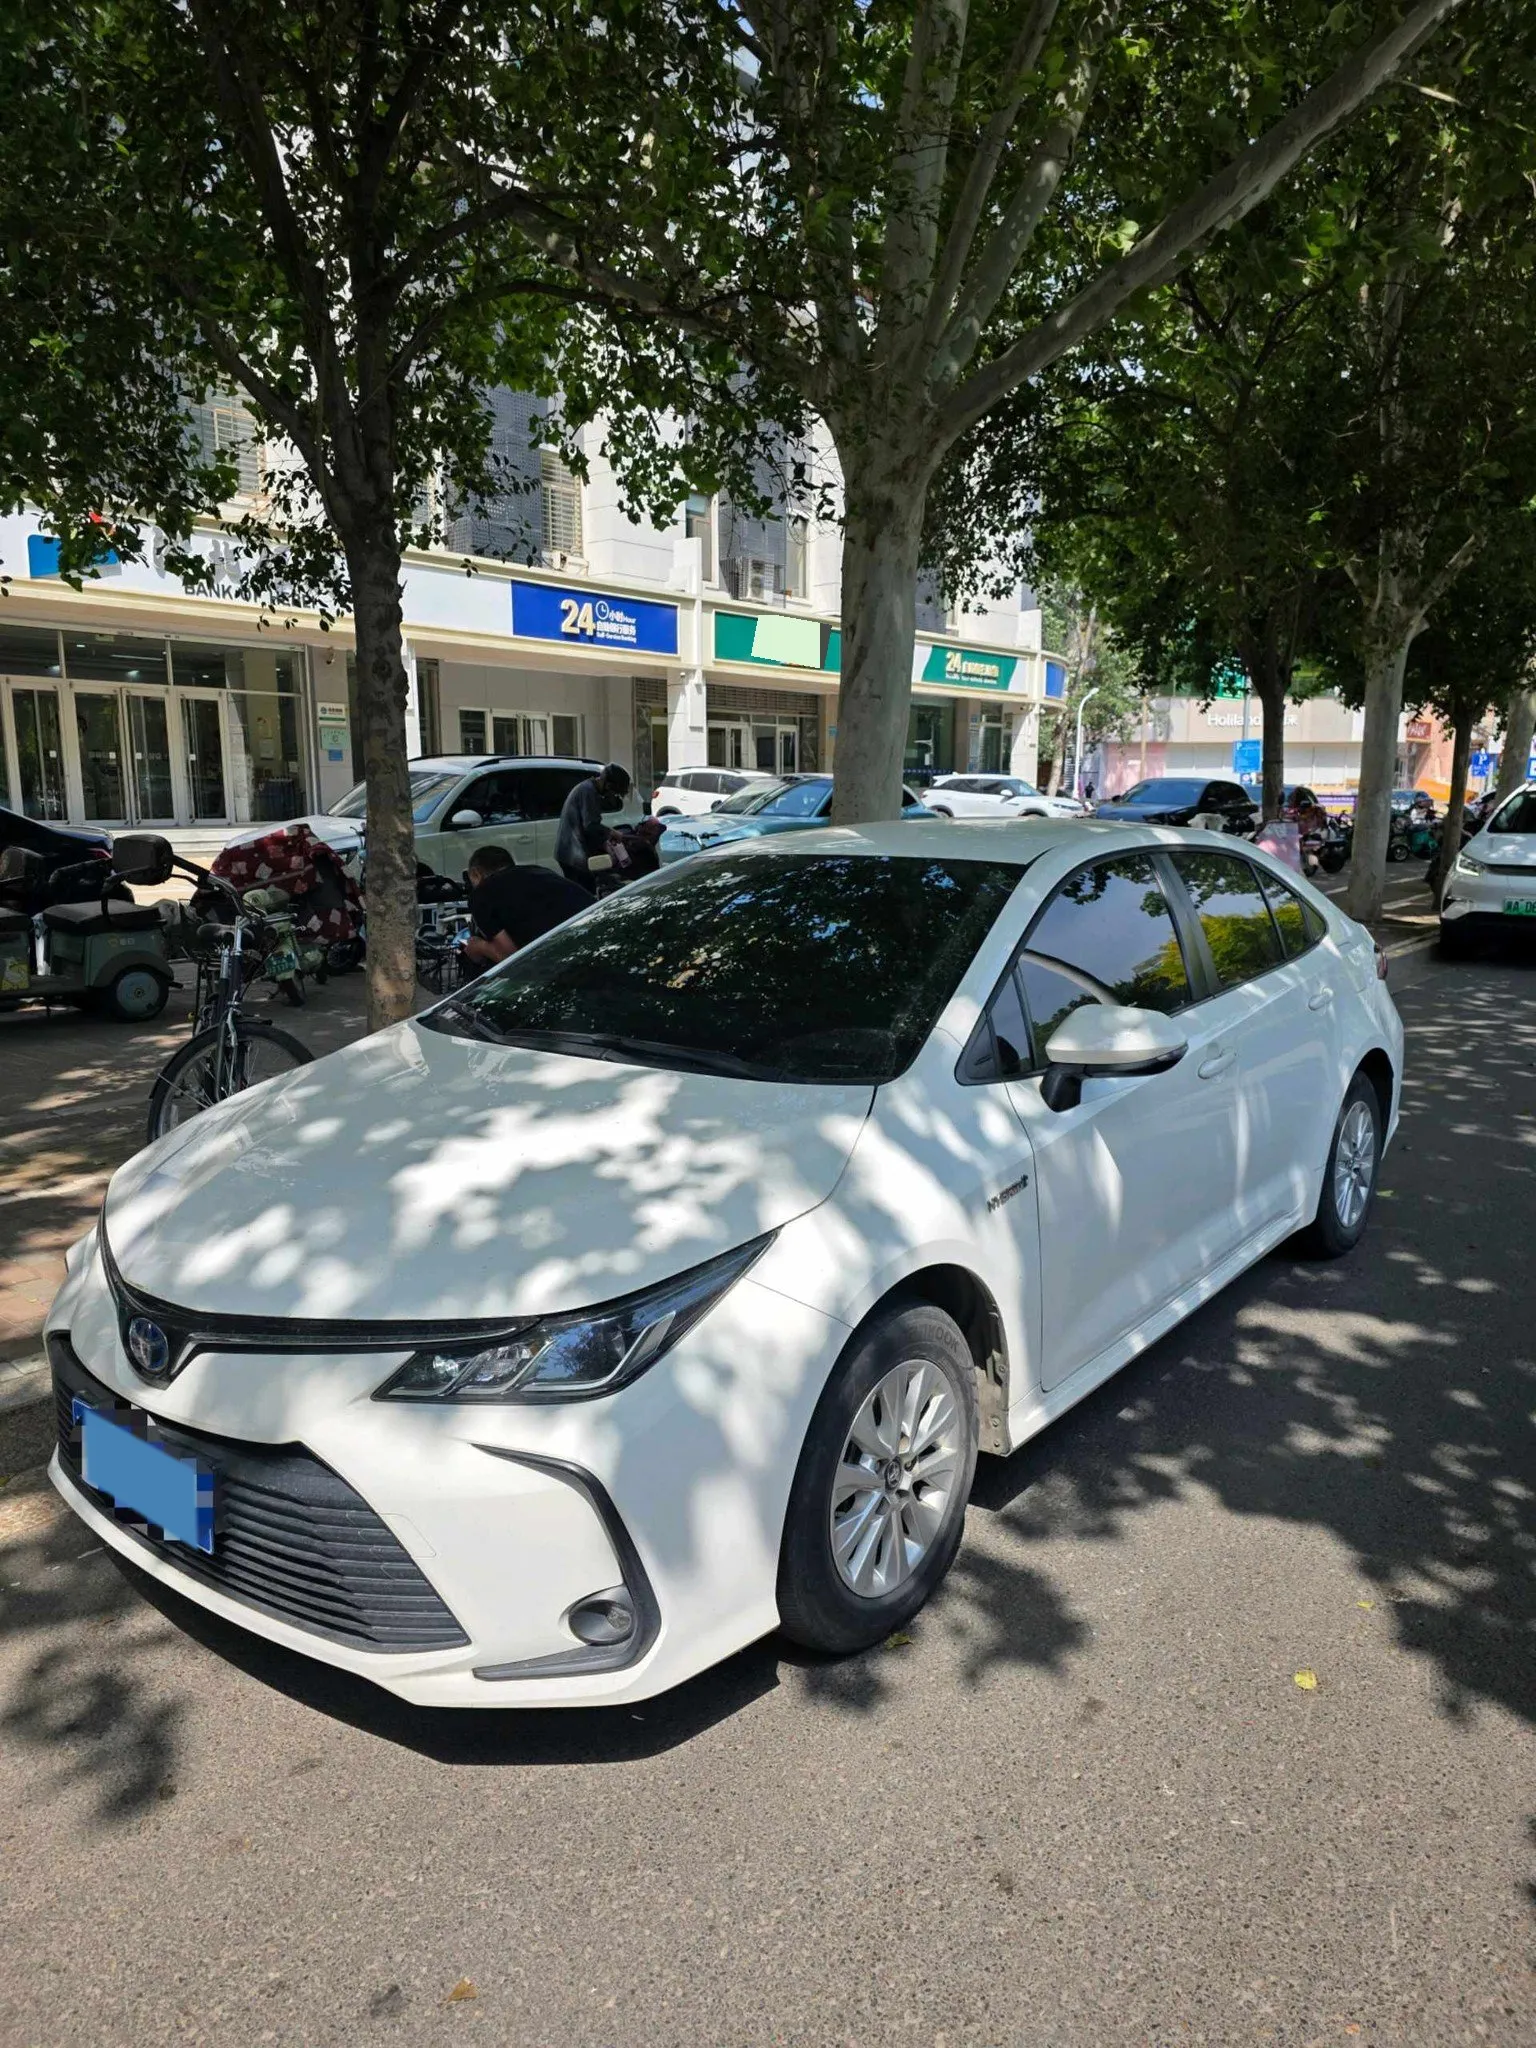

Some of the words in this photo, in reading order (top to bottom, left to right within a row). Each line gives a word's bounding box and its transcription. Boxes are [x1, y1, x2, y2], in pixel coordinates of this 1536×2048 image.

[184, 583, 234, 600] BANK
[561, 599, 595, 636] 24
[945, 651, 962, 673] 24
[1478, 753, 1488, 765] P
